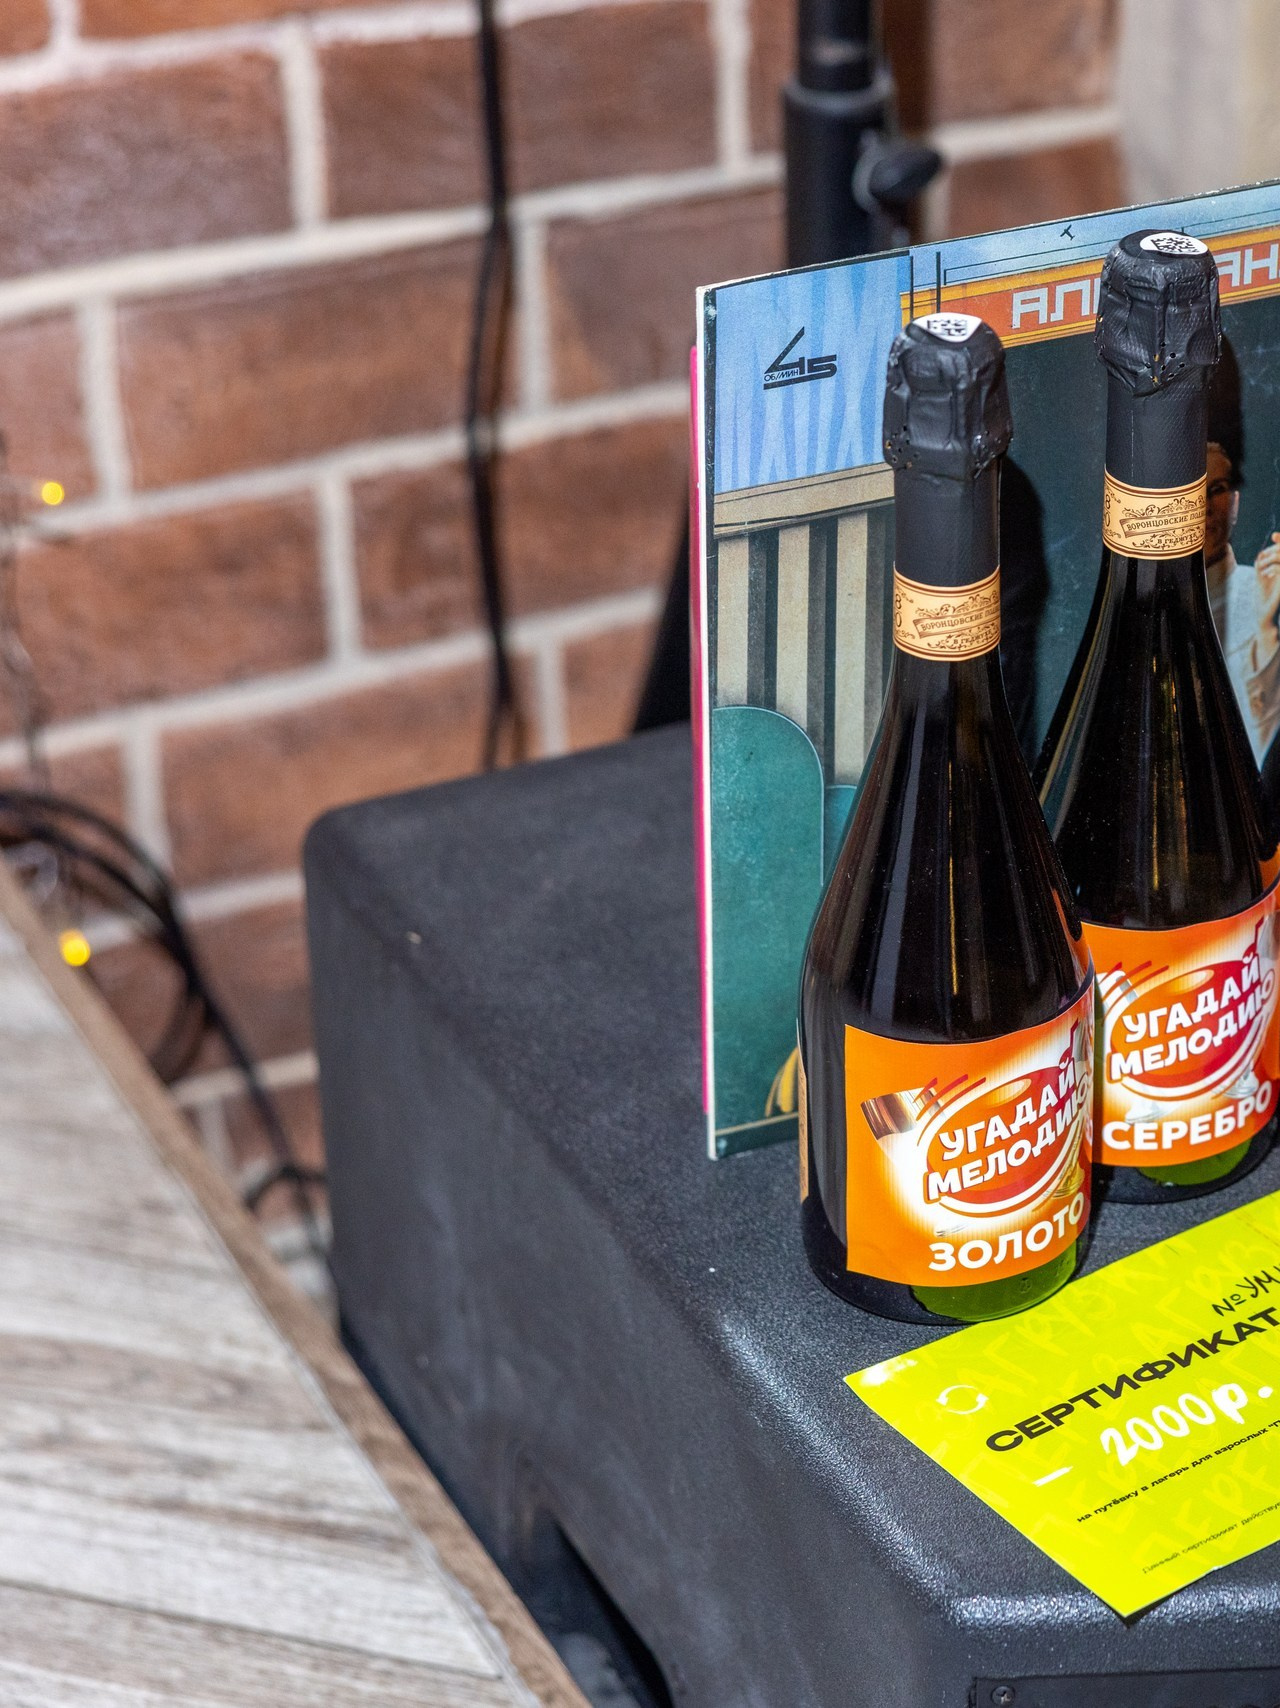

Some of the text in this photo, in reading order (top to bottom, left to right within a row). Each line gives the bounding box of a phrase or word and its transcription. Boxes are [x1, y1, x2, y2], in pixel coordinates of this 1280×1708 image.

[763, 326, 838, 391] 45
[1126, 514, 1189, 531] ВОРОНЦОВСКИЕ
[920, 612, 984, 632] ВОРОНЦОВСКИЕ
[1111, 968, 1275, 1081] МЕЛОДИЮ
[1122, 952, 1260, 1044] УГАДАЙ
[928, 1072, 1090, 1200] МЕЛОДИЮ
[938, 1057, 1075, 1160] УГАДАЙ
[1102, 1080, 1272, 1151] СЕРЕБРО
[928, 1192, 1085, 1272] ЗОЛОТО
[985, 1306, 1280, 1452] СЕРТИФИКАТ
[1077, 1513, 1092, 1523] на
[1094, 1490, 1138, 1514] путёвку
[1151, 1466, 1190, 1488] лагерь
[1191, 1453, 1213, 1468] для
[1214, 1428, 1269, 1456] взрослых
[1182, 1523, 1239, 1554] сертификат
